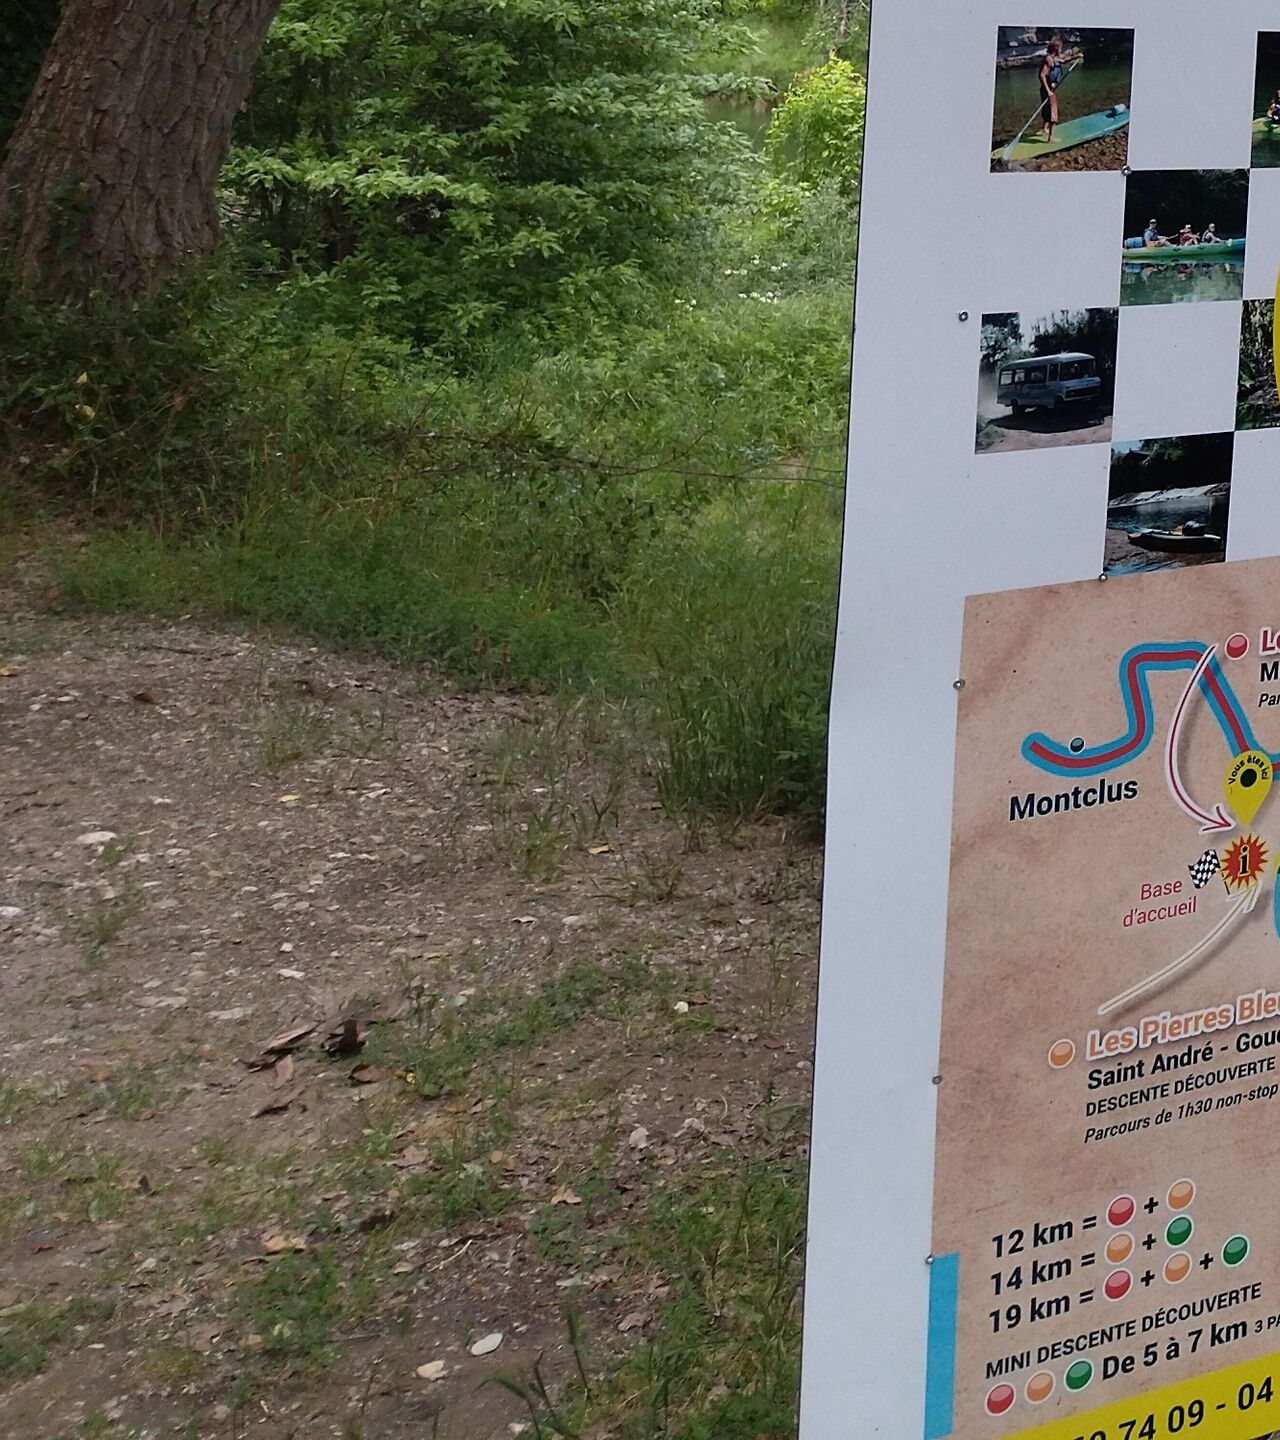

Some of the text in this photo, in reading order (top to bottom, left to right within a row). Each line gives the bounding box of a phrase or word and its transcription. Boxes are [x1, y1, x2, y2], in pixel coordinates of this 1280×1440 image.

[1009, 779, 1138, 822] Montclus
[1123, 897, 1196, 928] d'accueil
[1140, 880, 1183, 900] Base
[1088, 1030, 1134, 1058] Les
[1141, 1006, 1231, 1045] Pierres
[1085, 1056, 1276, 1117] DESCENTE DÉCOUVERTE
[1087, 1063, 1145, 1090] Saint
[1151, 1043, 1213, 1075] André
[1084, 1082, 1279, 1143] Parcours de 1h30 non-stop
[992, 1229, 1025, 1258] 12
[1032, 1217, 1073, 1249] km
[991, 1264, 1023, 1295] 14
[1031, 1256, 1071, 1285] km
[985, 1282, 1262, 1379] MINI DESCENTE DÉCOUVERTE
[989, 1300, 1022, 1332] 19
[1030, 1293, 1070, 1322] km
[1102, 1357, 1135, 1381] De
[1143, 1341, 1158, 1367] 5
[1165, 1335, 1179, 1359] à
[1190, 1330, 1203, 1355] 7
[1210, 1320, 1247, 1346] km
[1255, 1319, 1263, 1333] 3
[1118, 1414, 1157, 1440] 74
[1167, 1399, 1204, 1433] 09
[1237, 1375, 1273, 1411] 04
